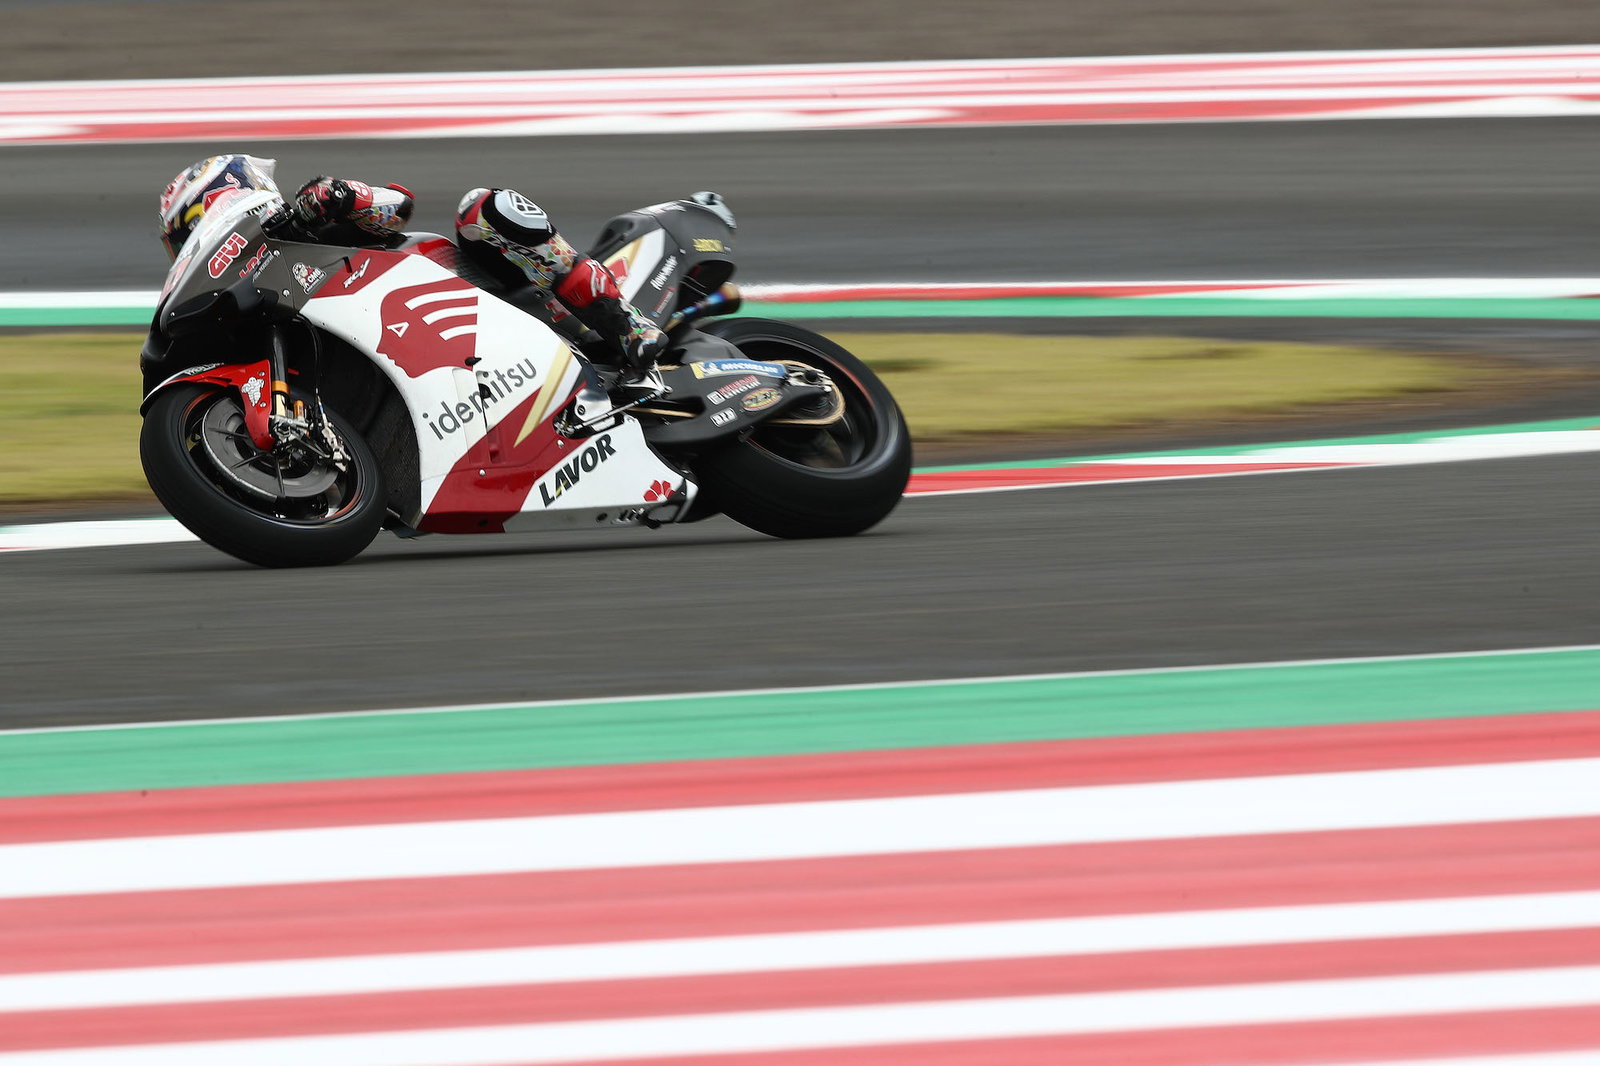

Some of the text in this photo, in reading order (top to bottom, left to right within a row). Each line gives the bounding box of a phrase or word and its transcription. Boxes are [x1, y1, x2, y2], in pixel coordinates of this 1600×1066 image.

[208, 232, 248, 279] GIVI
[422, 358, 537, 441] idemitsu
[538, 433, 617, 508] LAVOR
